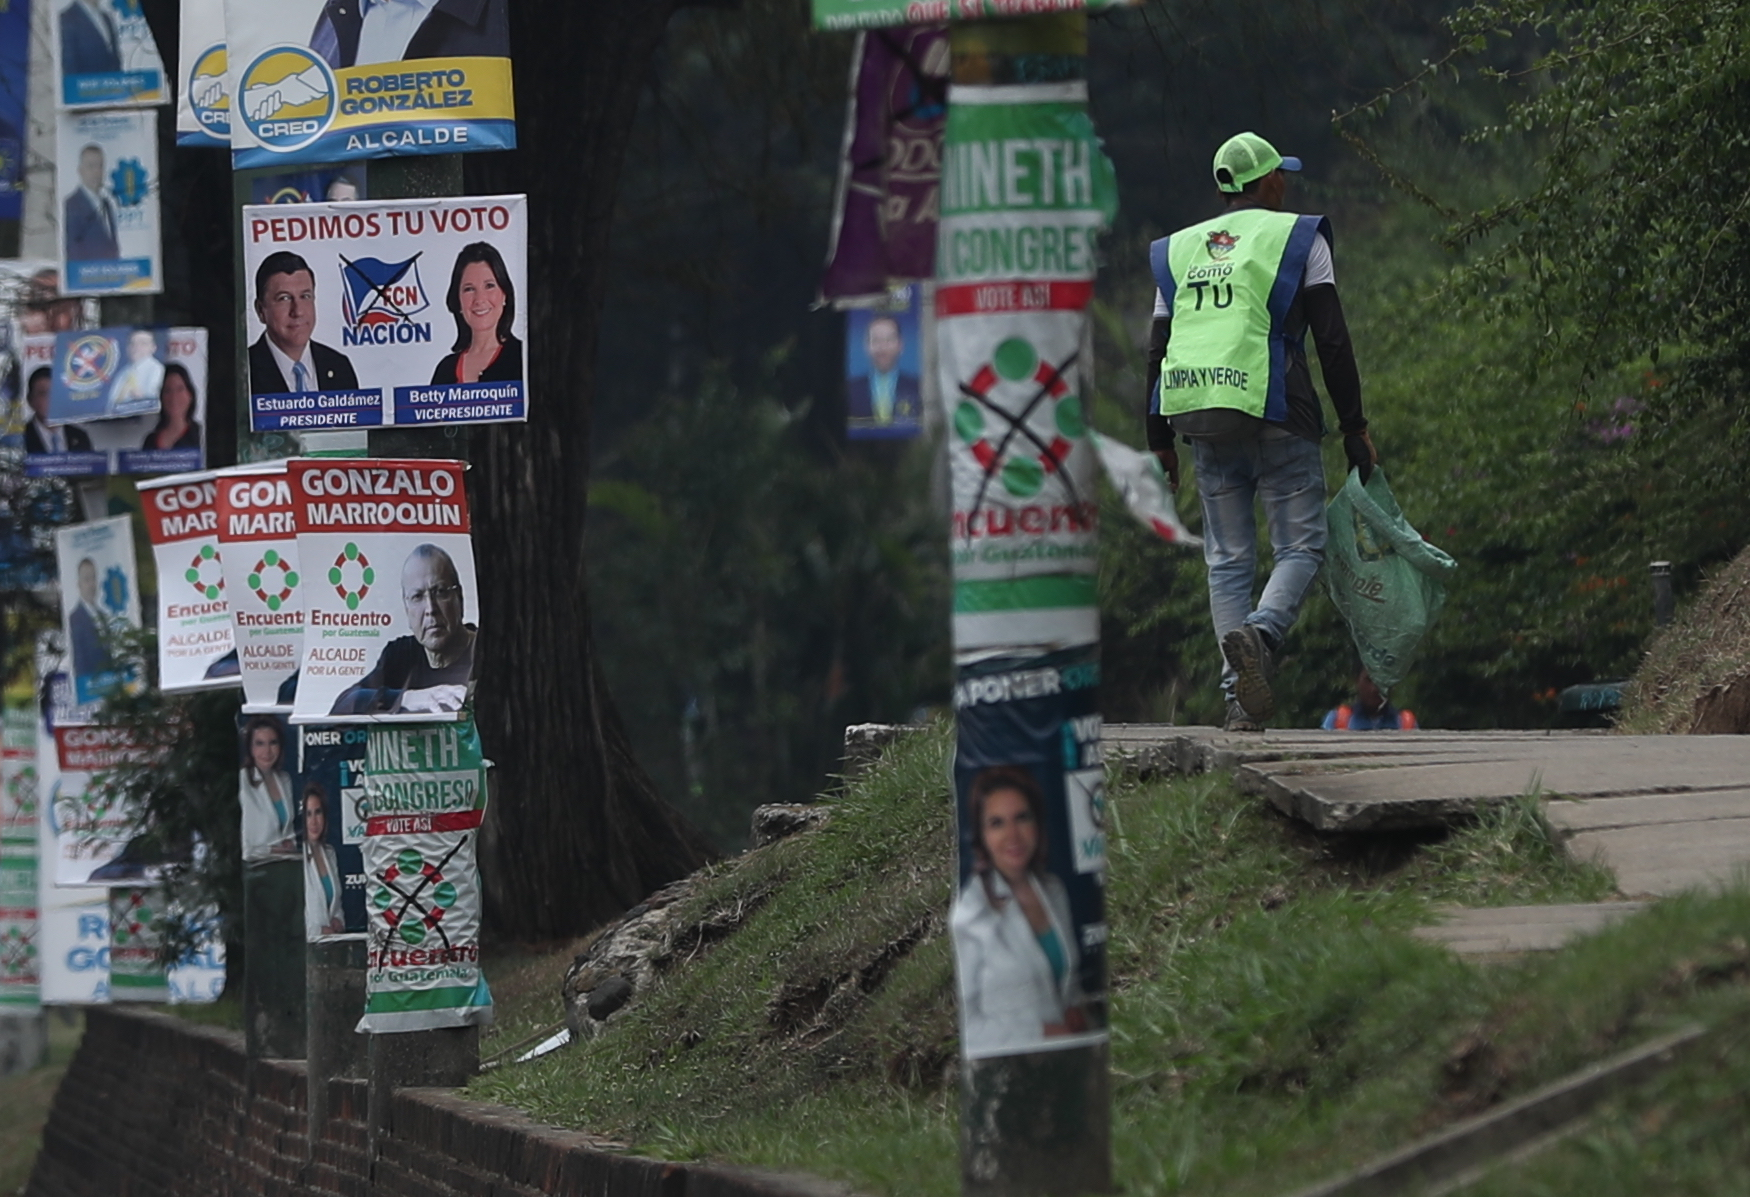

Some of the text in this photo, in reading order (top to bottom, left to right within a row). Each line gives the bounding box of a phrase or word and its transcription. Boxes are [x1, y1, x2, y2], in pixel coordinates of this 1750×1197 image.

[346, 69, 465, 95] ROBERTO
[340, 87, 473, 116] GONZÁLEZ
[346, 127, 468, 150] ALCALDE
[251, 205, 510, 243] PEDIMOS TU VOTO
[1188, 266, 1233, 280] como
[382, 286, 419, 307] FCN
[975, 286, 1017, 310] VOTE
[1187, 278, 1233, 312] TÚ
[1164, 366, 1249, 391] LIMPIA Y VERDE
[256, 392, 381, 411] Estuardo Galdámez
[409, 384, 519, 405] Betty Marroquín
[279, 412, 357, 427] PRESIDENTE
[414, 404, 513, 421] VICEPRESIDENTE
[301, 468, 455, 497] GONZALO
[306, 497, 461, 526] MARROQUÍN
[311, 609, 392, 627] Encuentro
[167, 630, 232, 648] ALCALDE
[322, 627, 380, 639] por Guatemala
[242, 644, 294, 659] ALCALDE
[308, 647, 367, 662] ALCALDE
[245, 661, 297, 672] POR LA GENTE
[306, 666, 366, 676] POR LA GENTE
[386, 818, 412, 833] VOTE
